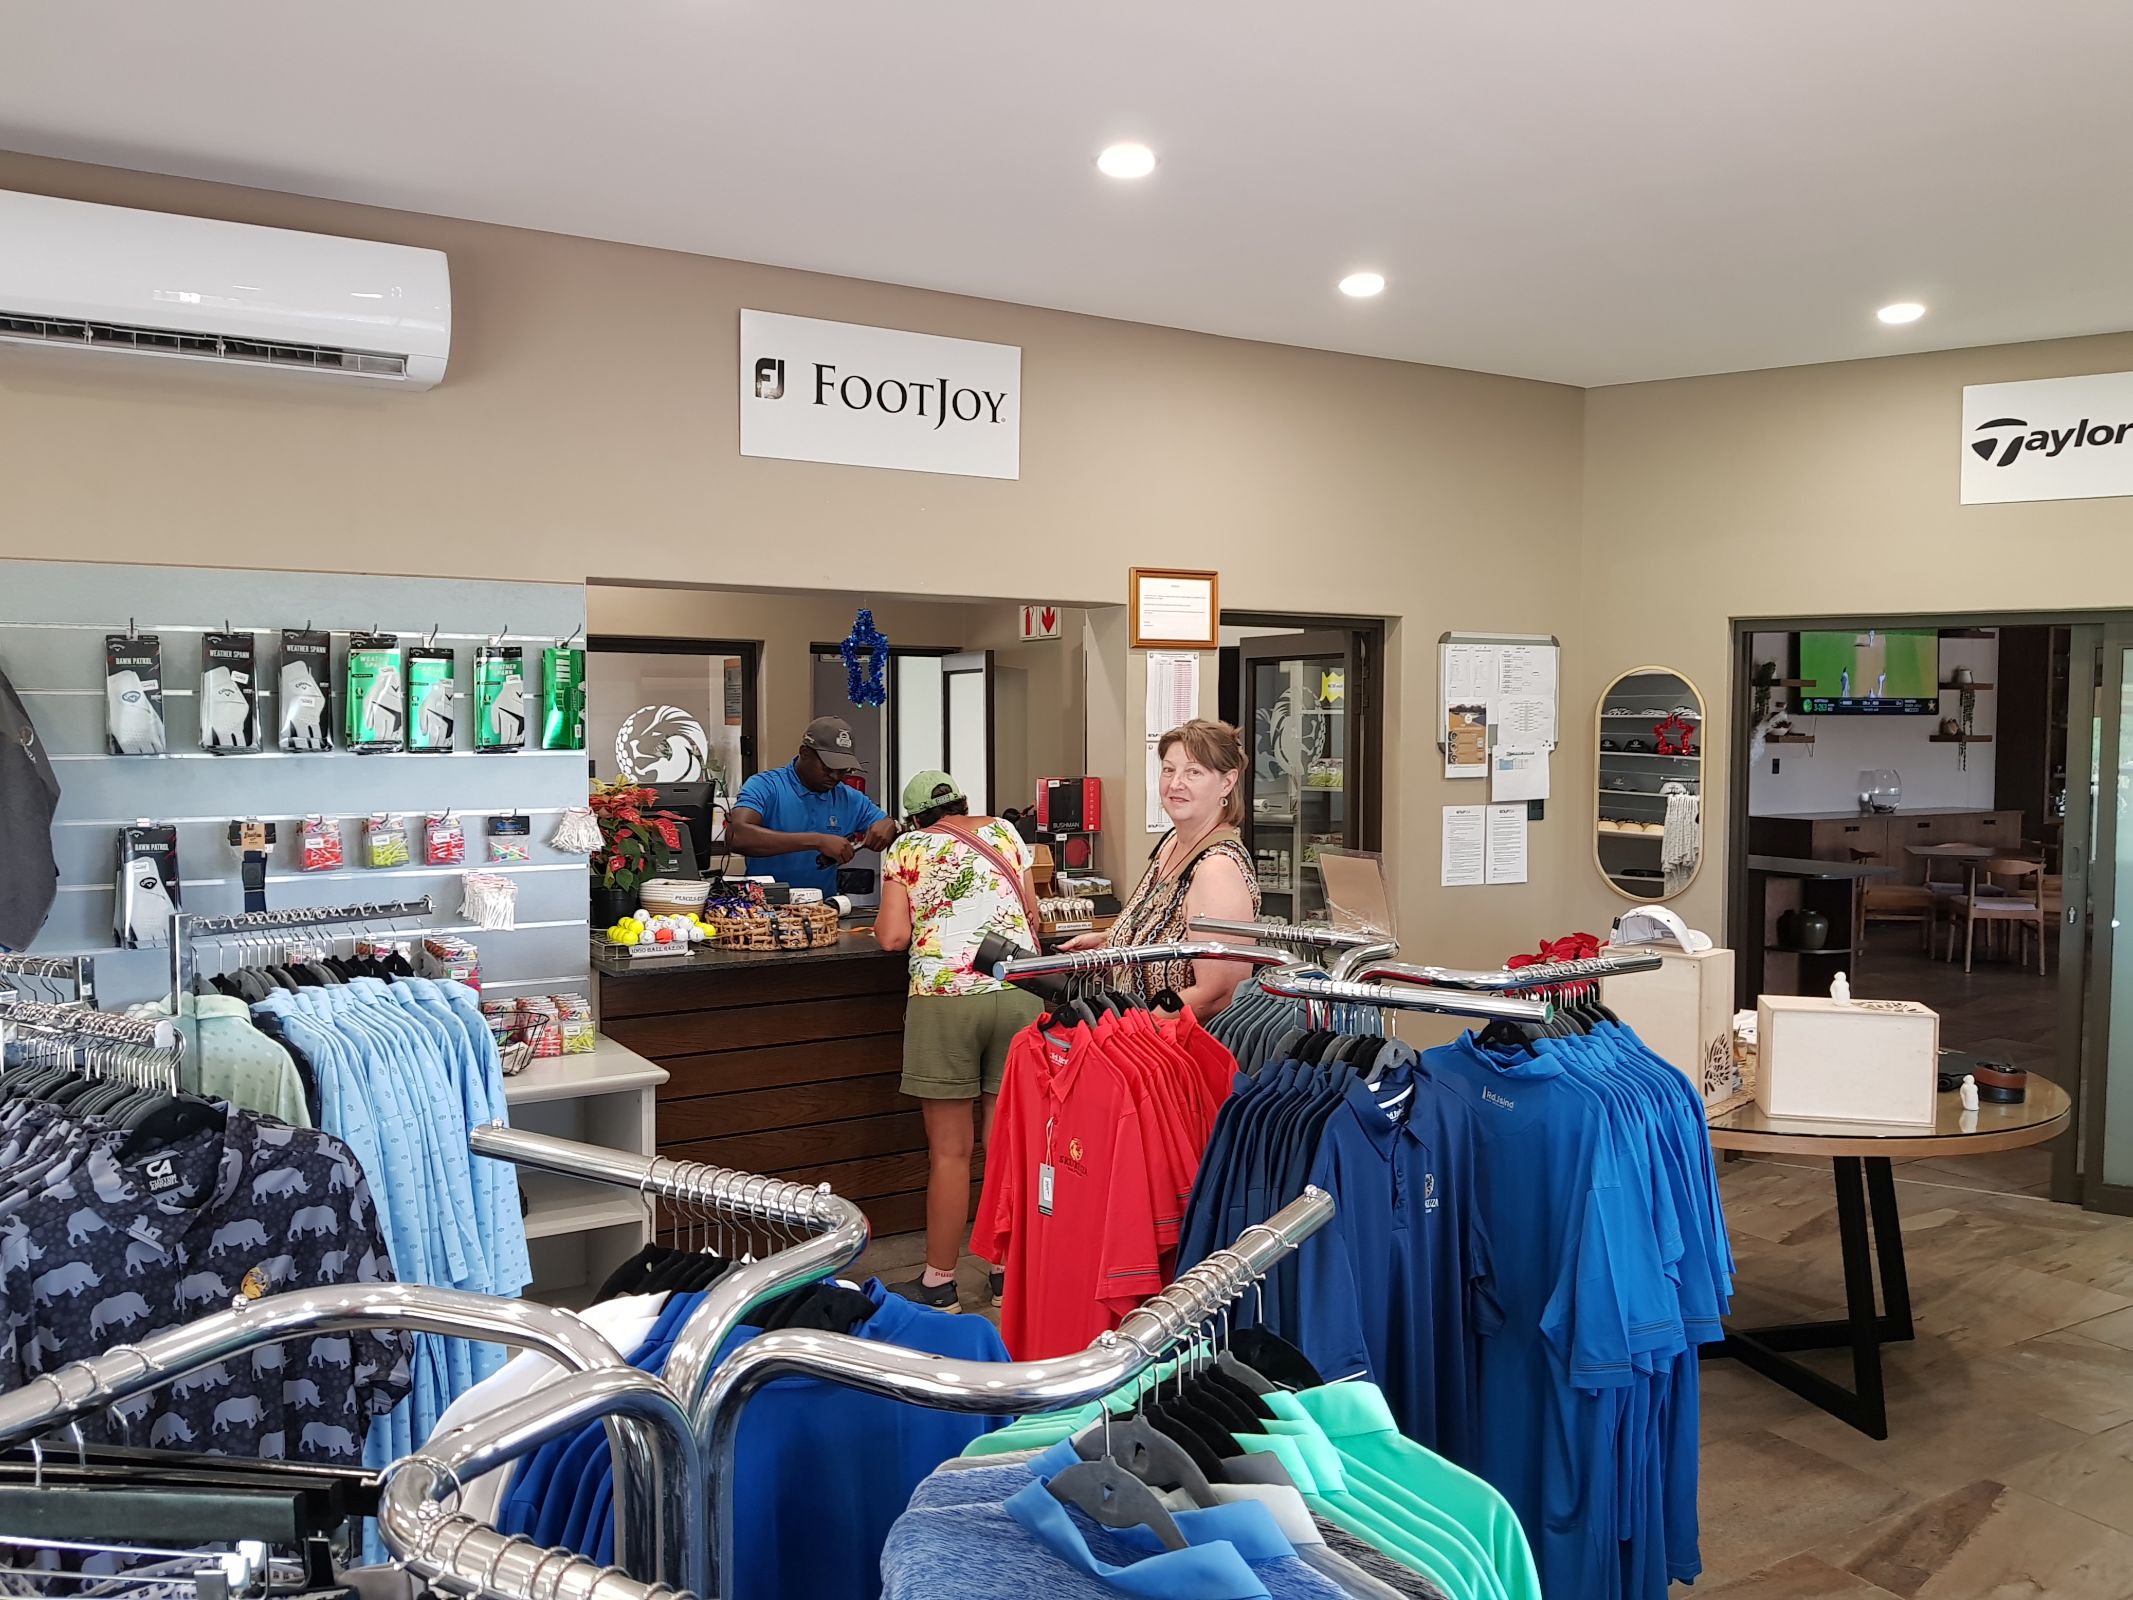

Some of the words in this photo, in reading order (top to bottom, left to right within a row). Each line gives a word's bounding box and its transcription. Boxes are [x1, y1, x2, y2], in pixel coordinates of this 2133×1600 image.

[1971, 417, 2133, 467] Taylor
[286, 644, 309, 652] WEATHER
[209, 649, 232, 657] WEATHER
[115, 657, 132, 665] DAWN
[132, 657, 153, 665] PATROL
[134, 843, 150, 851] DAWN
[150, 843, 169, 851] PATROL
[146, 1159, 173, 1178] CA
